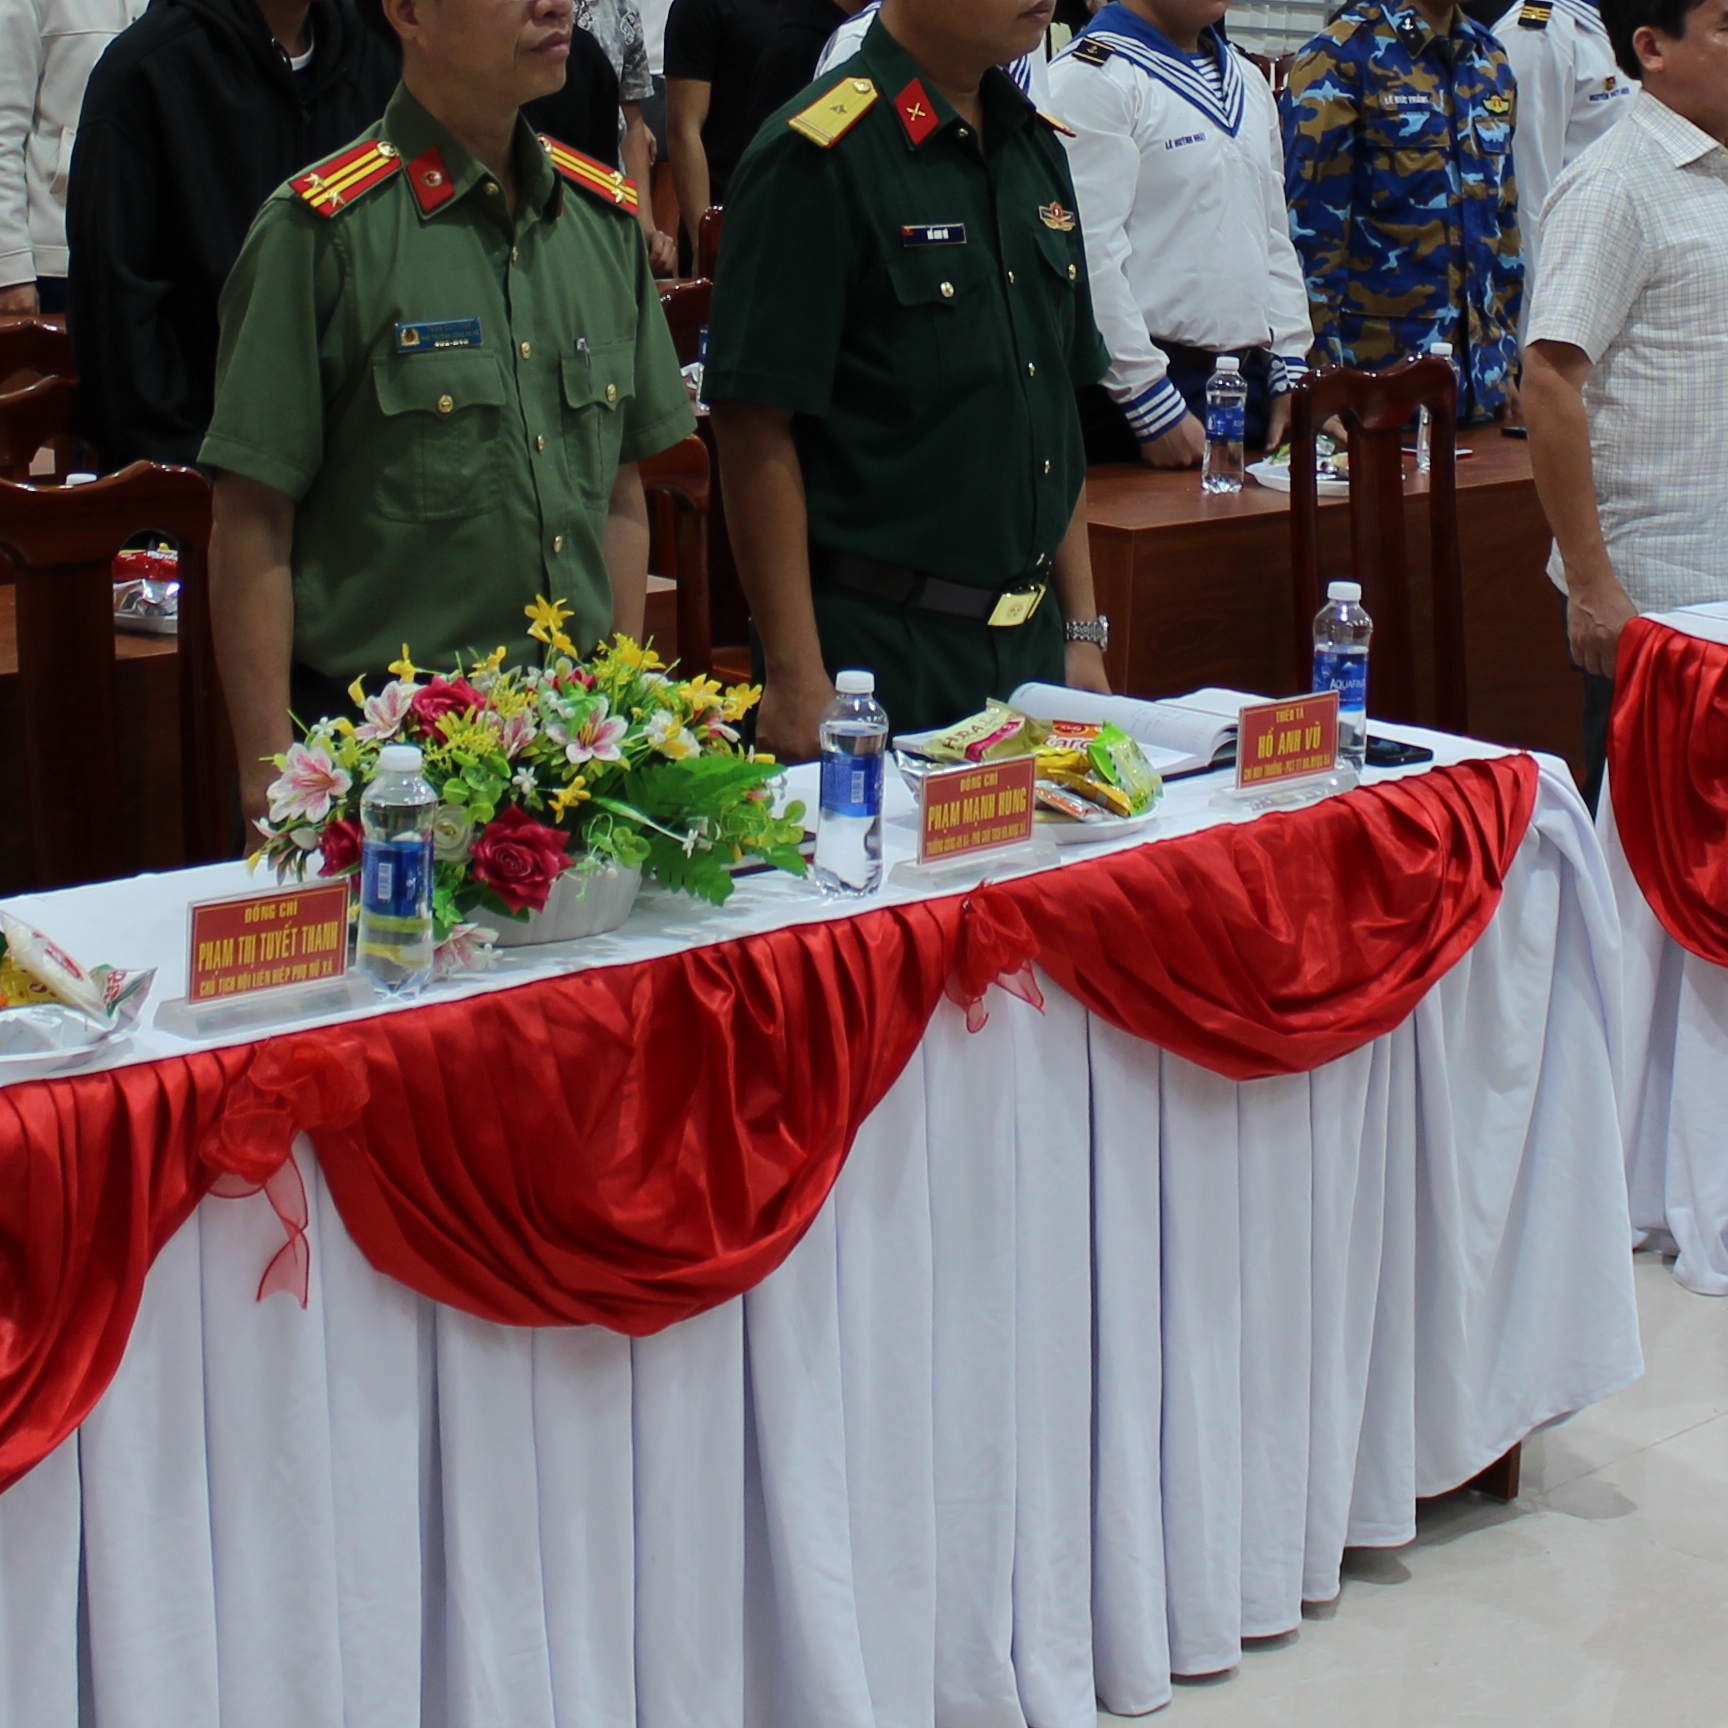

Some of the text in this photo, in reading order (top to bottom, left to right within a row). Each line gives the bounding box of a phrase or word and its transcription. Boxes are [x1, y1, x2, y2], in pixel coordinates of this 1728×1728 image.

[1278, 729, 1301, 755] ANH
[928, 801, 961, 833] PHẠM
[963, 794, 996, 827] MẠNH
[244, 898, 298, 924] ĐỒNG CHÍ
[198, 921, 339, 975] PHẠM THỊ TUYẾT THANH
